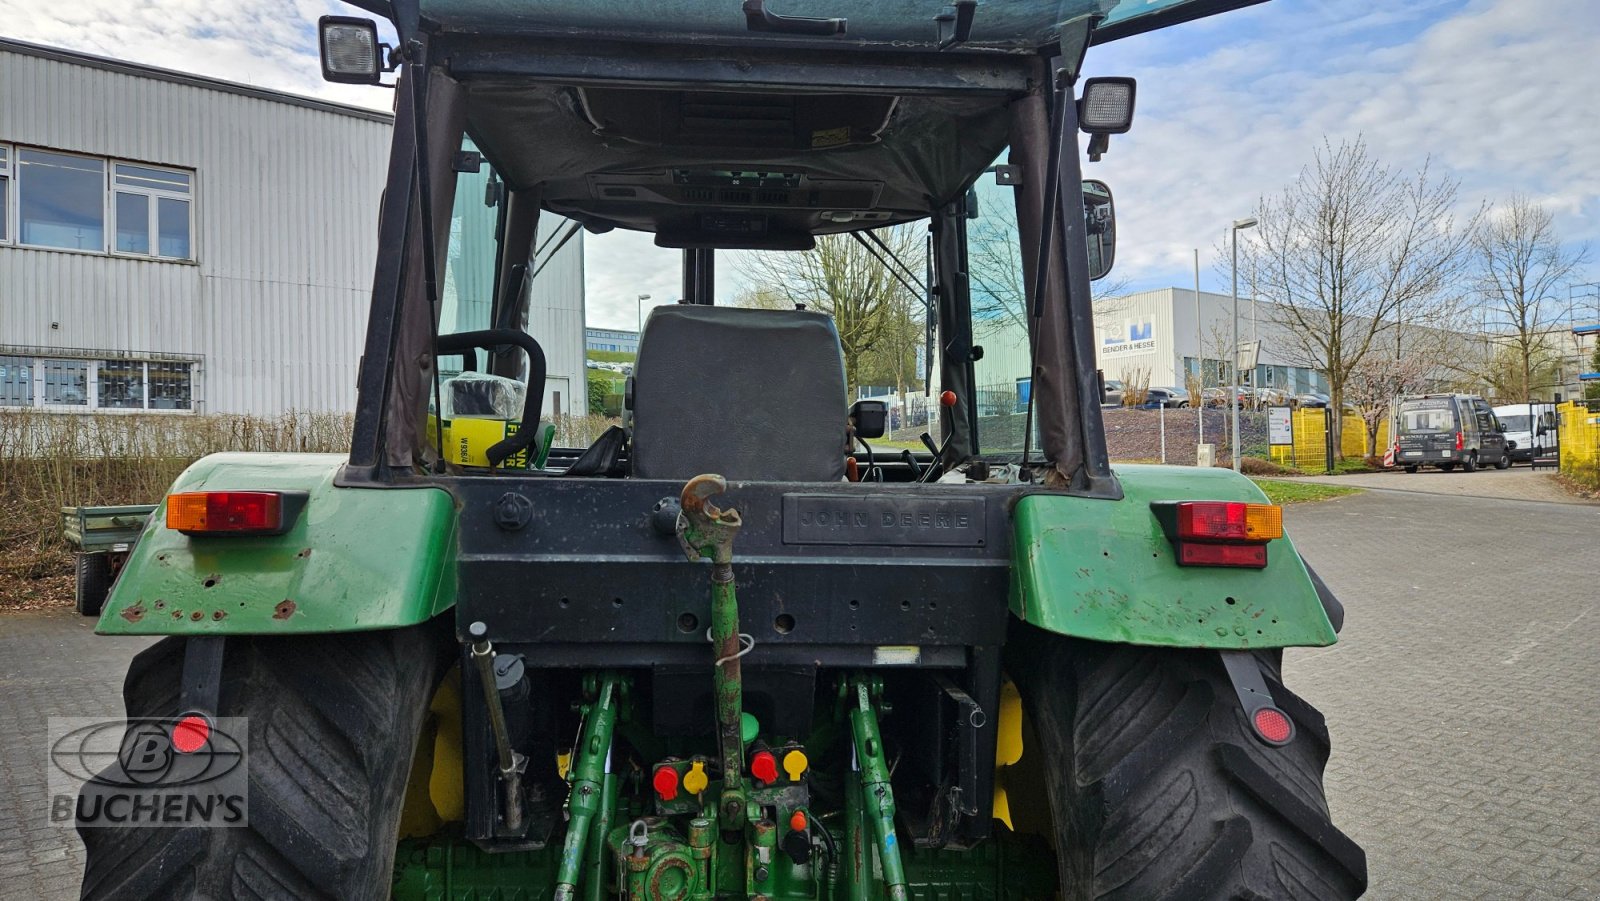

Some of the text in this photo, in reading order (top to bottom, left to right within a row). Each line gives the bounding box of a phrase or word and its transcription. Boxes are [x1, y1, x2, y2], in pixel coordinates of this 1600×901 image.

[1103, 345, 1128, 353] BENDER
[1134, 341, 1155, 349] HESSE
[800, 511, 969, 528] JOHN DEERE
